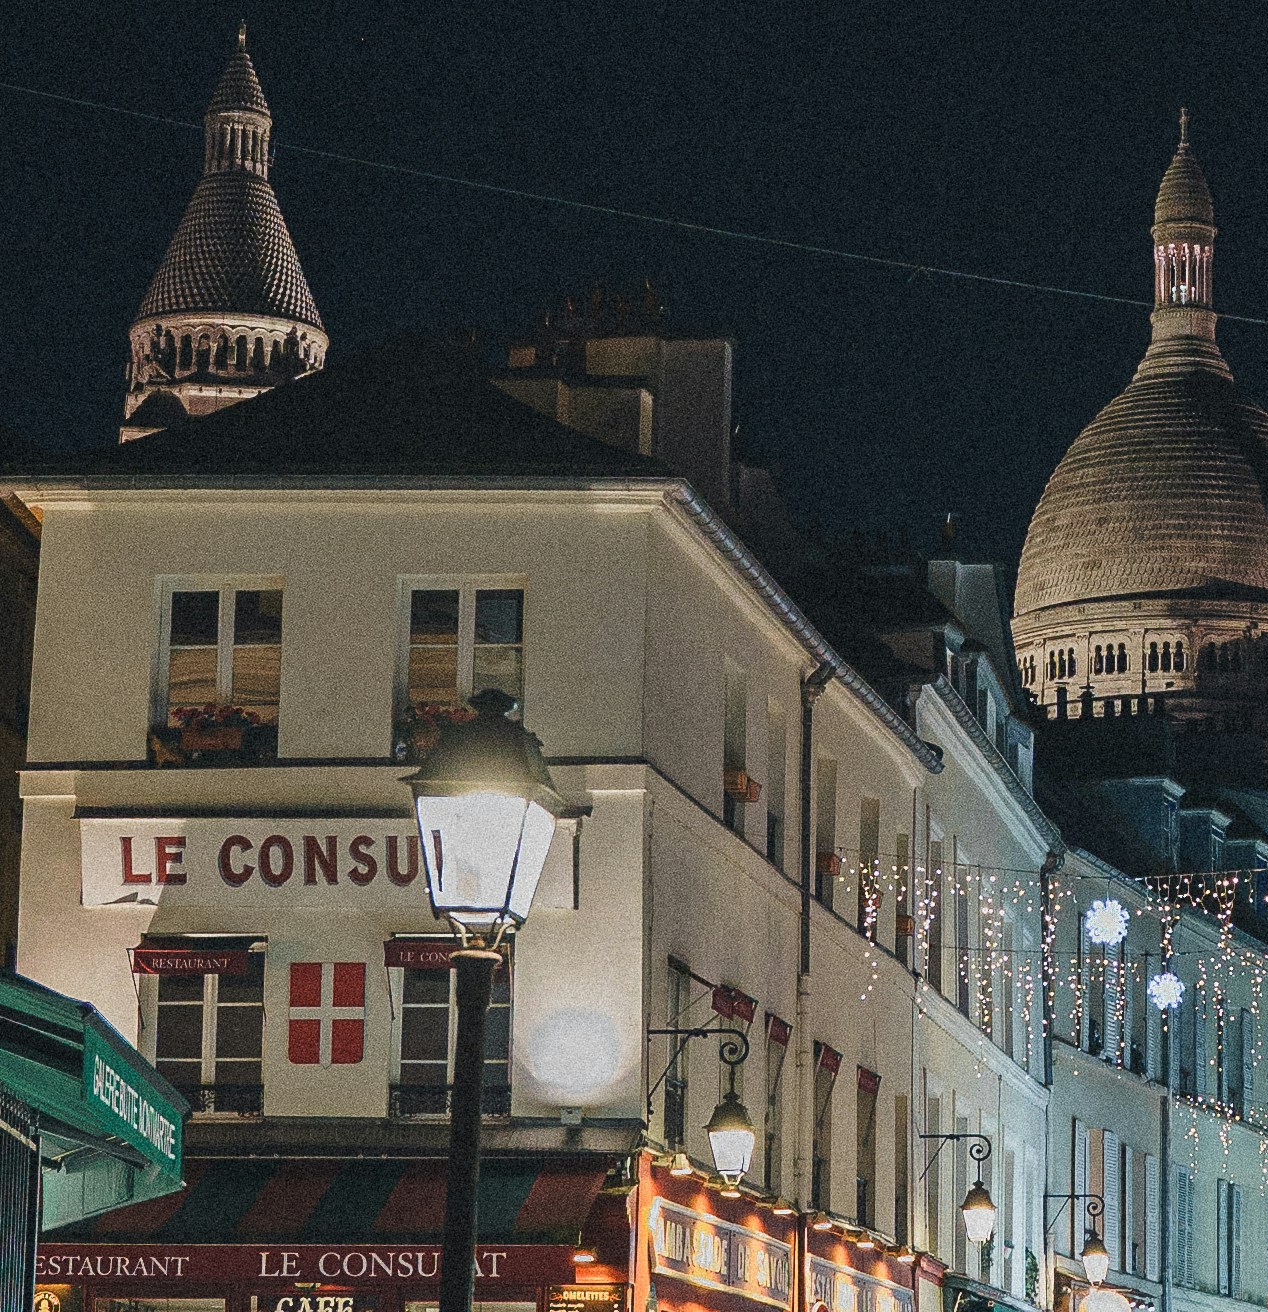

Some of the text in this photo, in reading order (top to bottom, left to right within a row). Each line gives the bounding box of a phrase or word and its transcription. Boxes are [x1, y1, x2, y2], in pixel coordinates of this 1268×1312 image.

[120, 831, 443, 891] LE CONSU
[152, 958, 230, 969] RESTAURANT
[400, 951, 450, 962] LE CON
[35, 1255, 190, 1277] ESTAURANT
[258, 1252, 507, 1278] LE CONSUAT
[563, 1291, 609, 1300] OMELETTES
